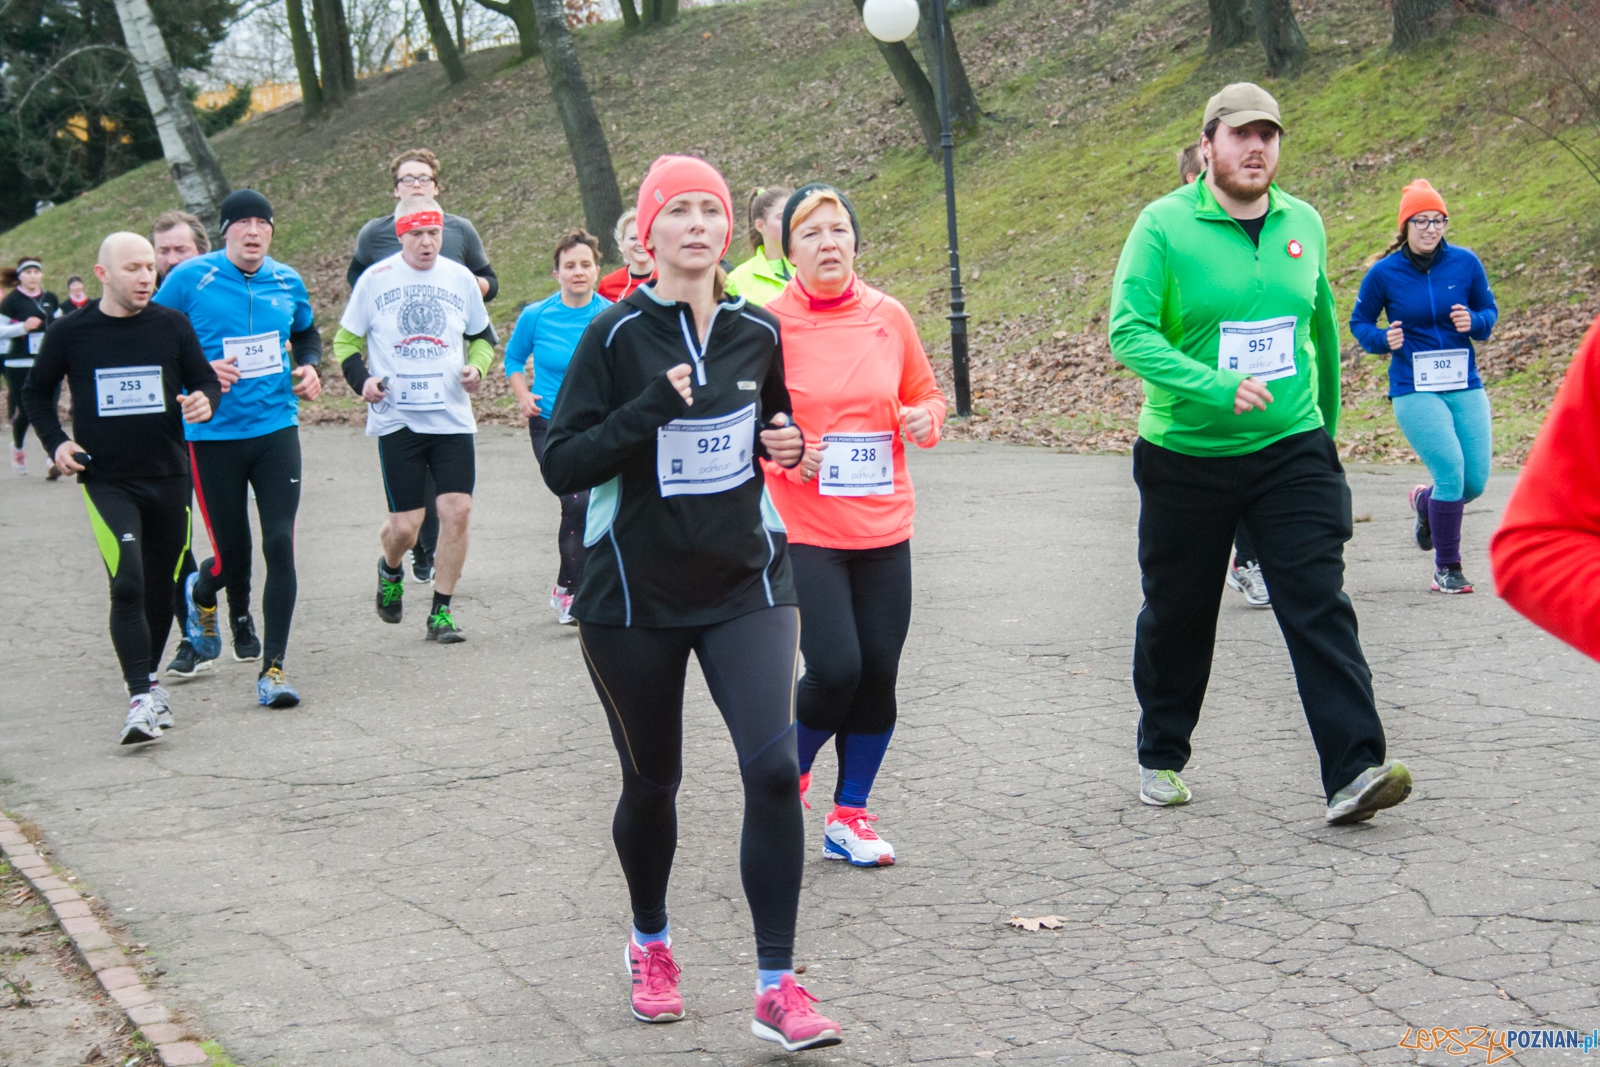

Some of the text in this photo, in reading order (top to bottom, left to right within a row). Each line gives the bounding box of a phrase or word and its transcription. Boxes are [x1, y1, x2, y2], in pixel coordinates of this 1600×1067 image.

[245, 345, 263, 356] 254
[1249, 337, 1273, 353] 957
[1433, 359, 1451, 369] 302
[120, 380, 141, 391] 253
[411, 381, 428, 390] 888
[697, 434, 731, 454] 922
[851, 448, 876, 461] 238
[699, 458, 731, 475] parkrun
[851, 466, 876, 480] parkrun
